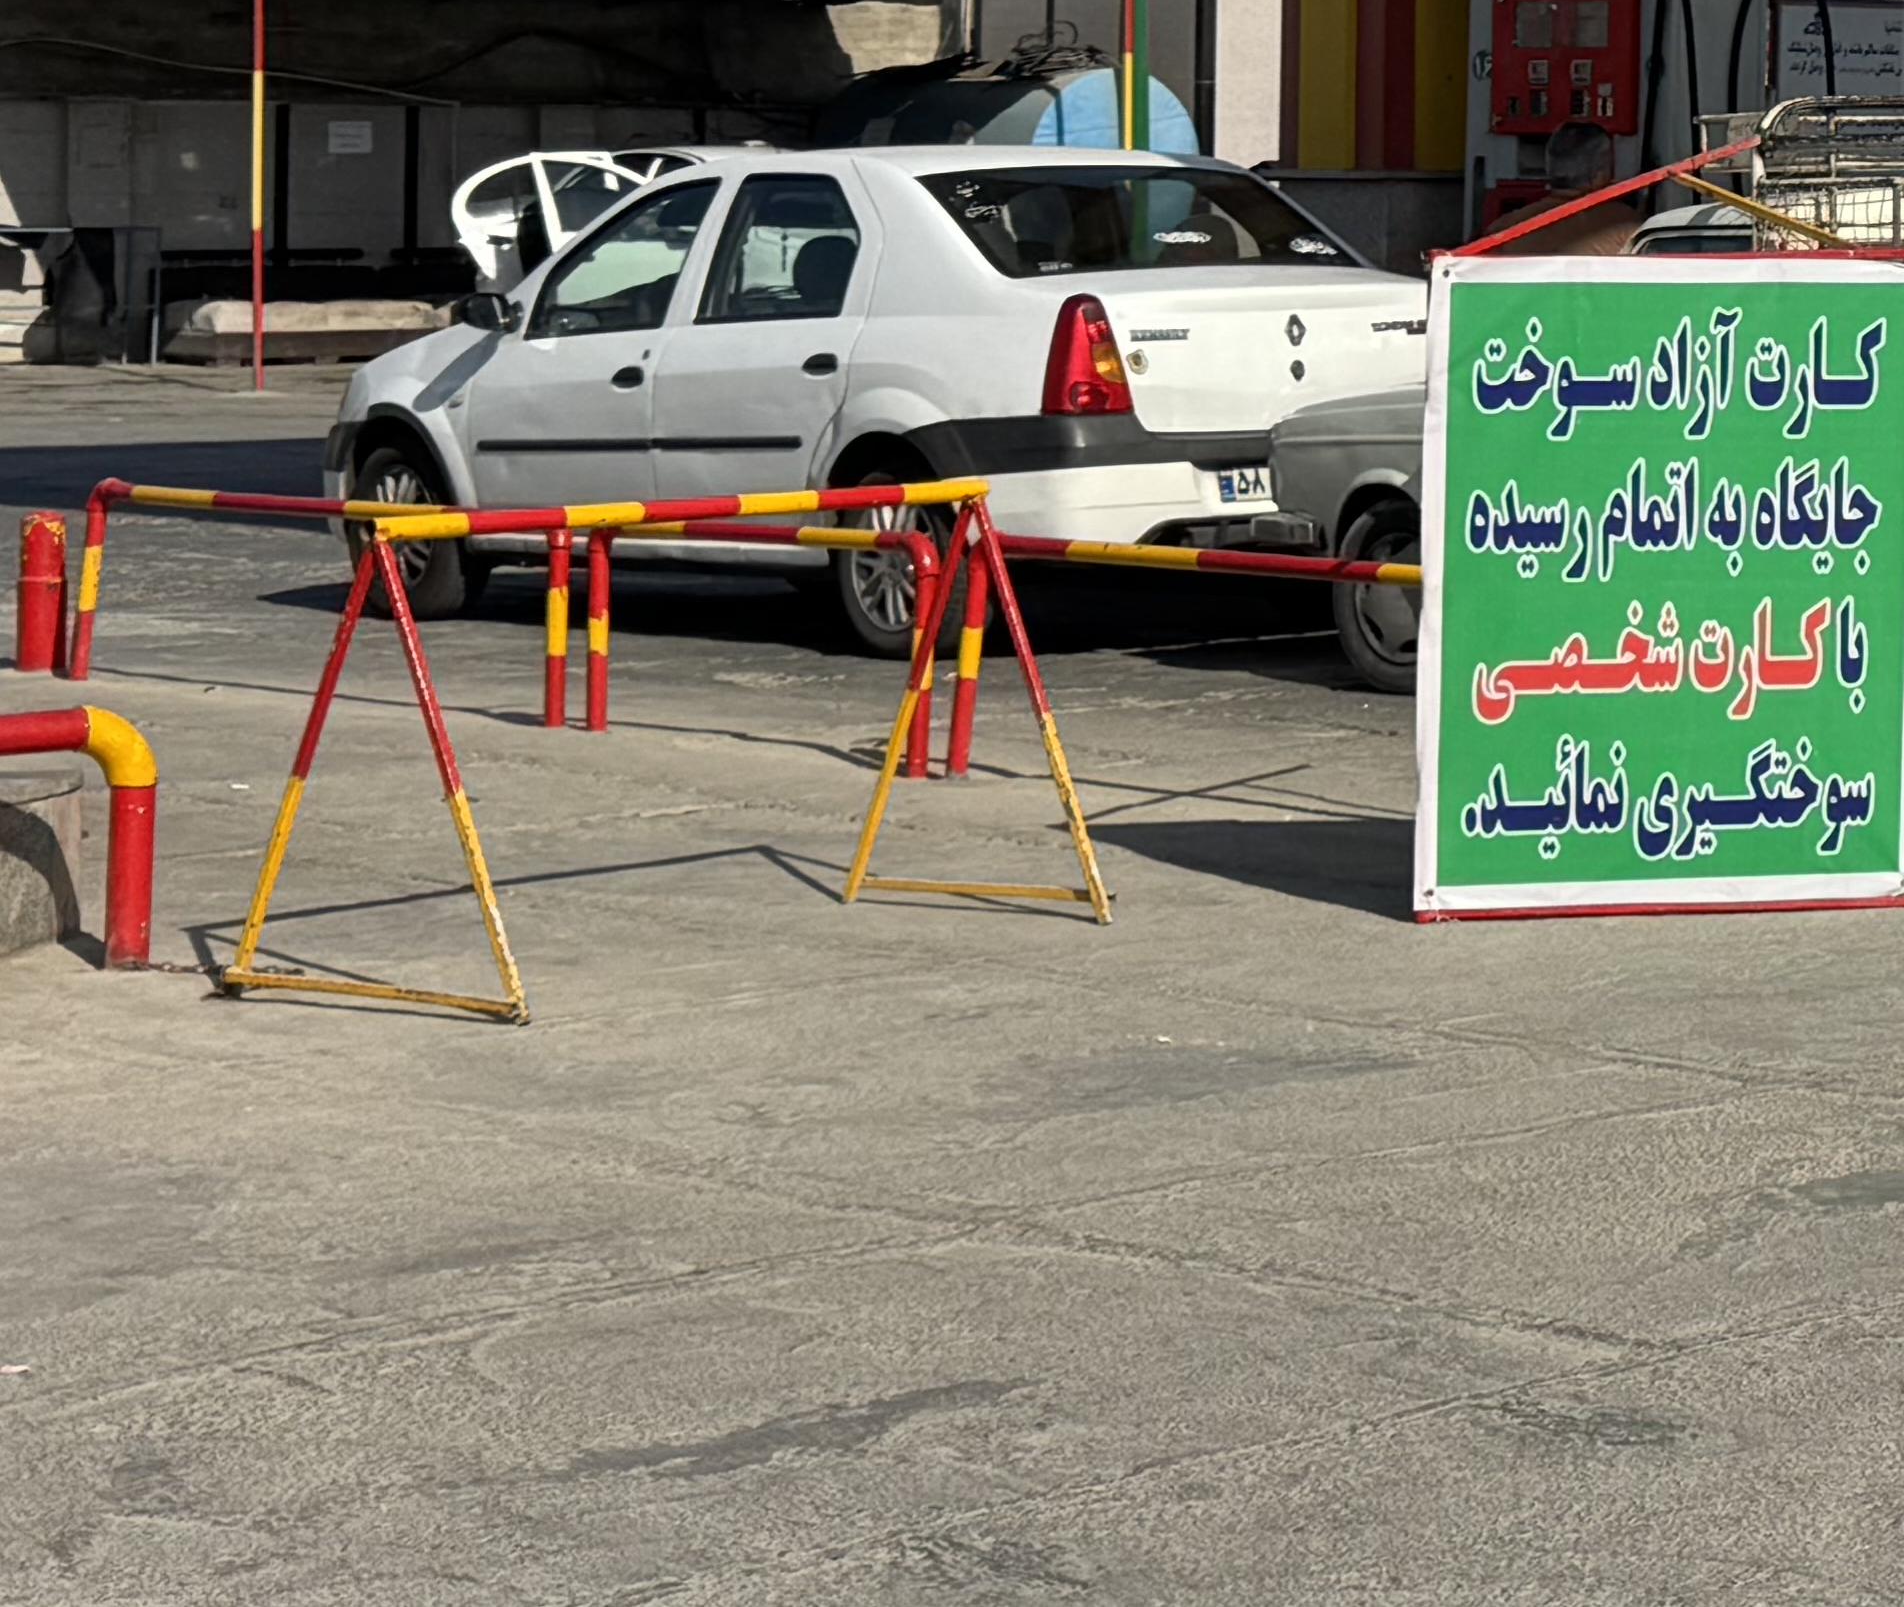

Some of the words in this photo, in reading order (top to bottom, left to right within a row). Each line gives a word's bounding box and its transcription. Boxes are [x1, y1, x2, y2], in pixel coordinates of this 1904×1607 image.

[1471, 317, 1642, 442] سوخت
[1646, 306, 1743, 441] آزاد
[1745, 314, 1888, 440] کارت
[1464, 479, 1592, 583] رسیده
[1597, 455, 1700, 583] اتمام
[1703, 477, 1748, 577] به
[1750, 455, 1882, 575] جایگاه
[1471, 599, 1685, 726] شخصی
[1689, 595, 1832, 720] کارت
[1834, 594, 1870, 715] با
[1460, 733, 1631, 859] نمائید.
[1632, 734, 1877, 861] سوختگیری
